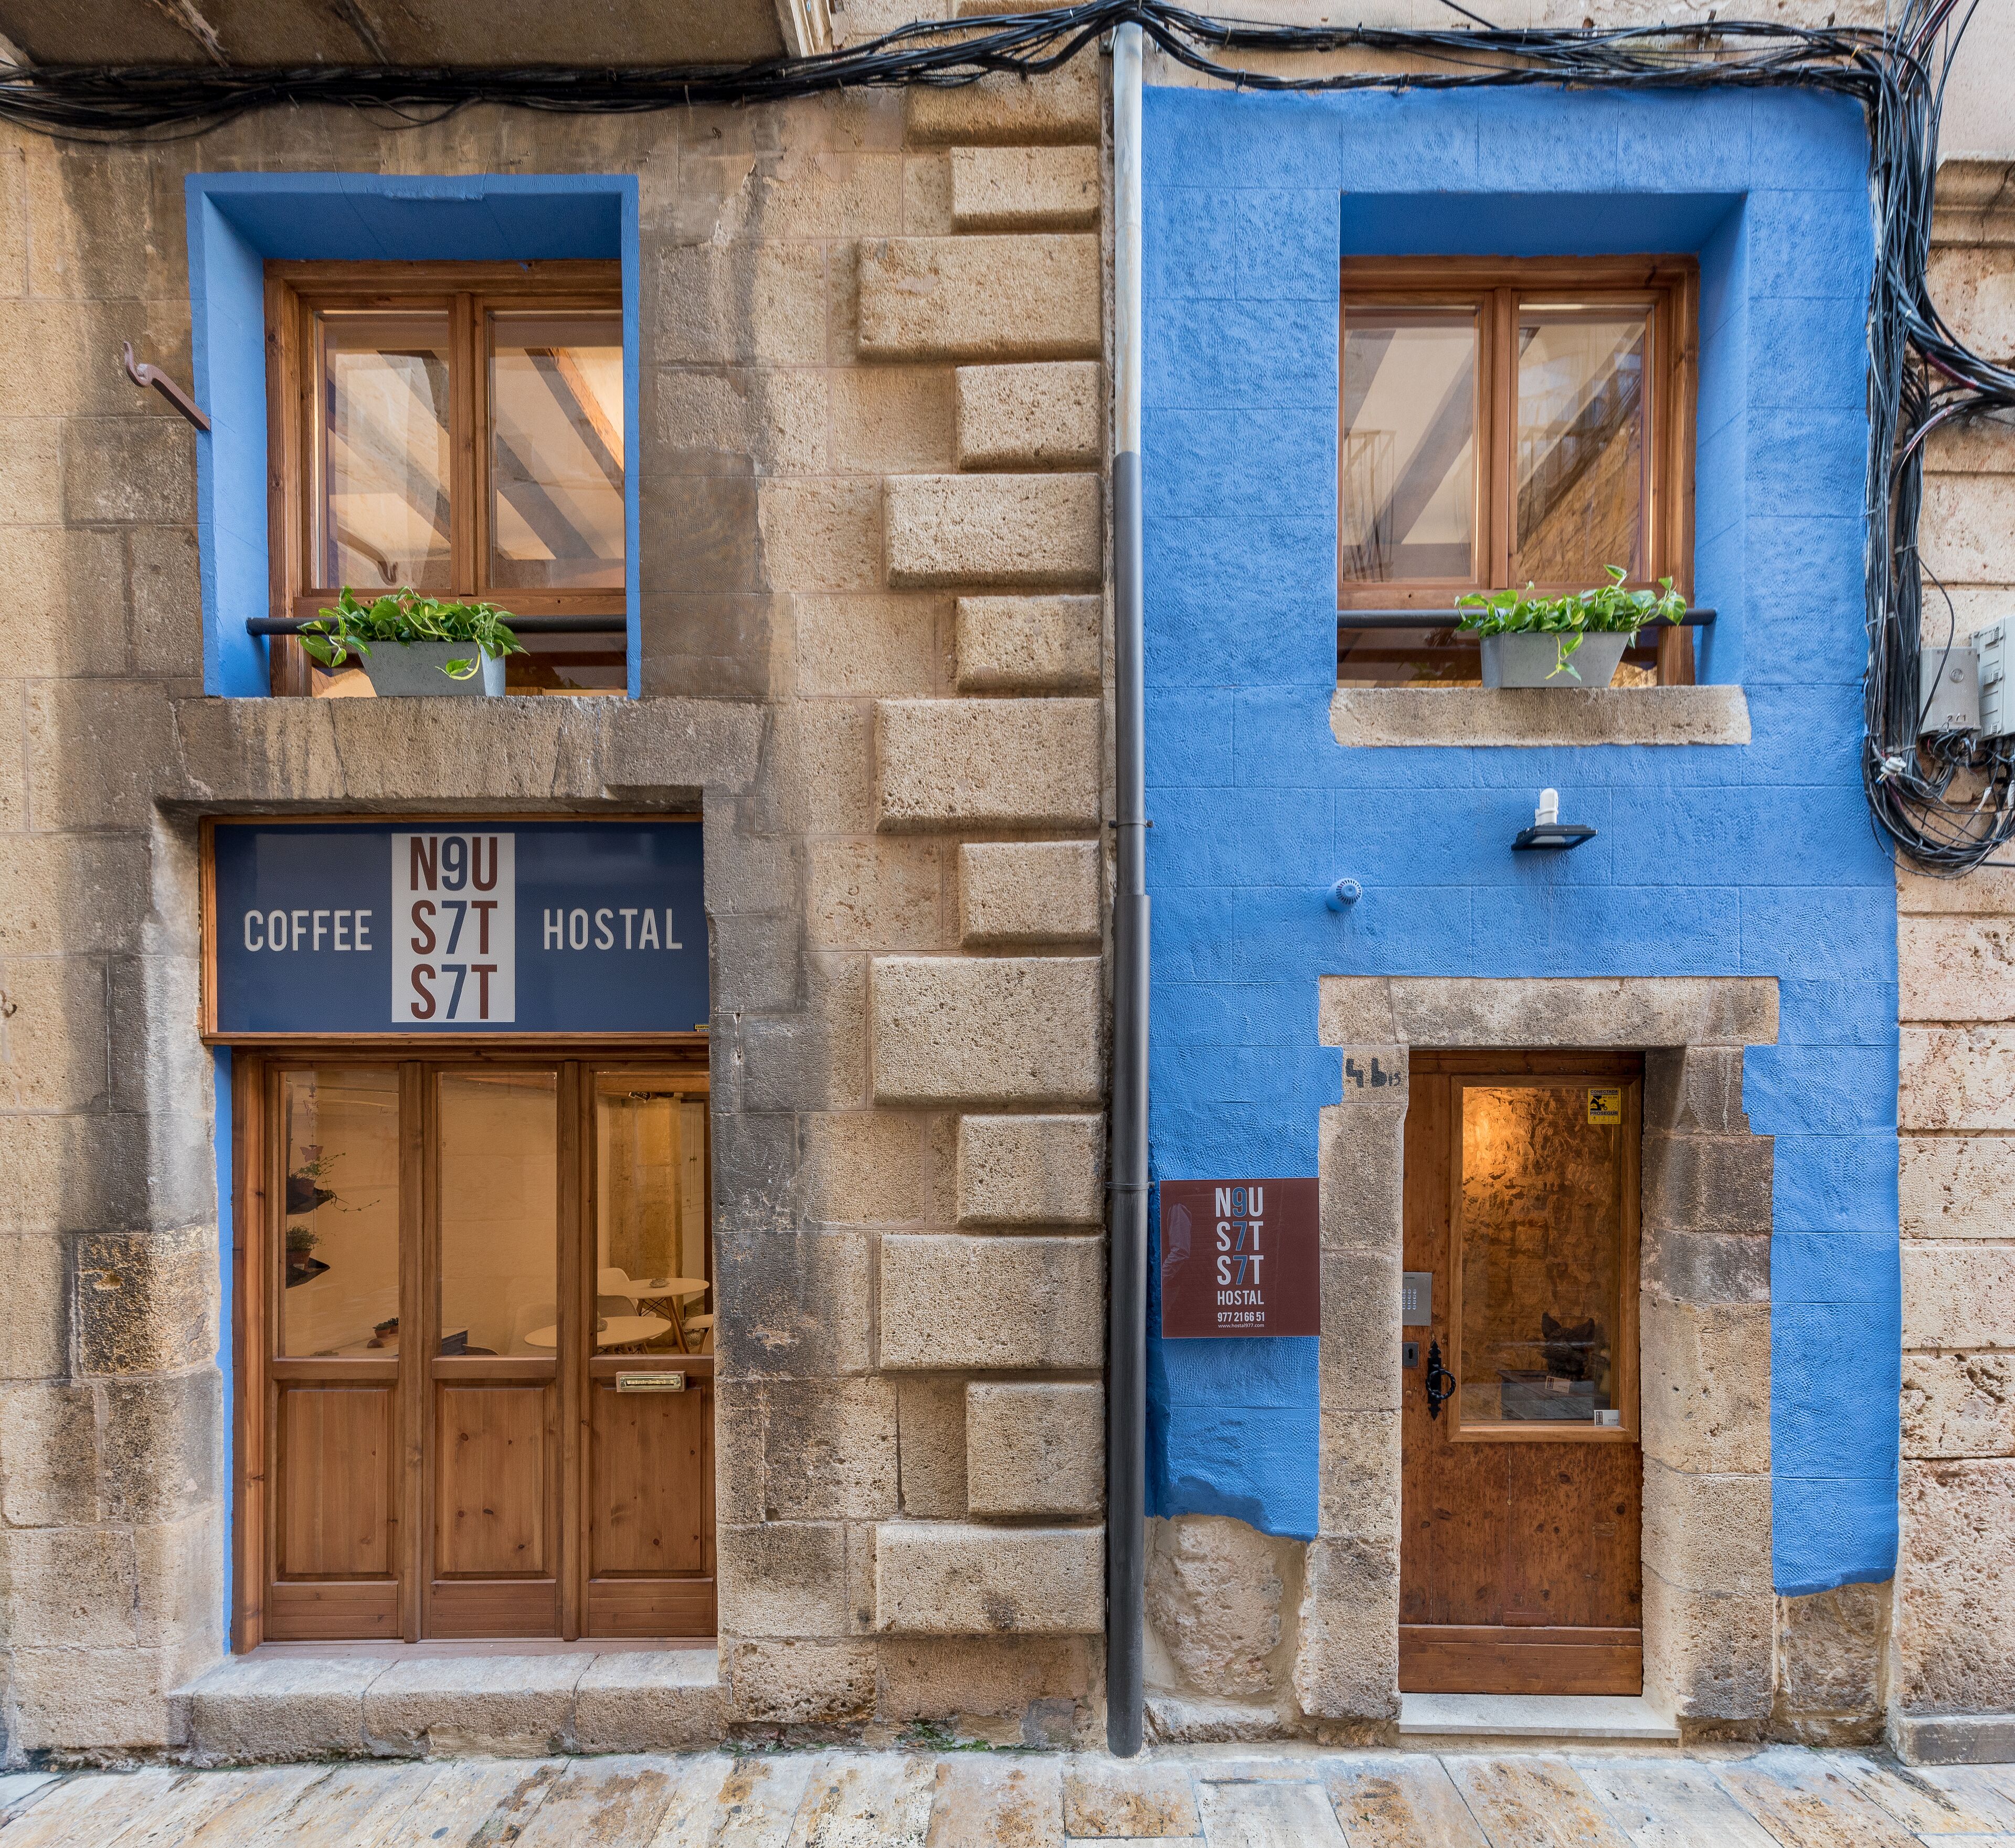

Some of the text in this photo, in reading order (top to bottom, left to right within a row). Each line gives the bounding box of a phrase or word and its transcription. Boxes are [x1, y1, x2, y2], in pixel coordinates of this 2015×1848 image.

[409, 836, 498, 891] N9U
[243, 909, 373, 951] COFFEE
[411, 900, 498, 955] S7T
[543, 908, 683, 950] HOSTAL
[410, 963, 497, 1020] S7T
[1345, 1058, 1364, 1088] 4
[1215, 1187, 1264, 1217] N9U
[1216, 1221, 1264, 1251] S7T
[1217, 1255, 1264, 1285] S7T
[1217, 1290, 1264, 1305] HOSTAL
[1217, 1312, 1233, 1322] 977
[1256, 1312, 1265, 1322] 51
